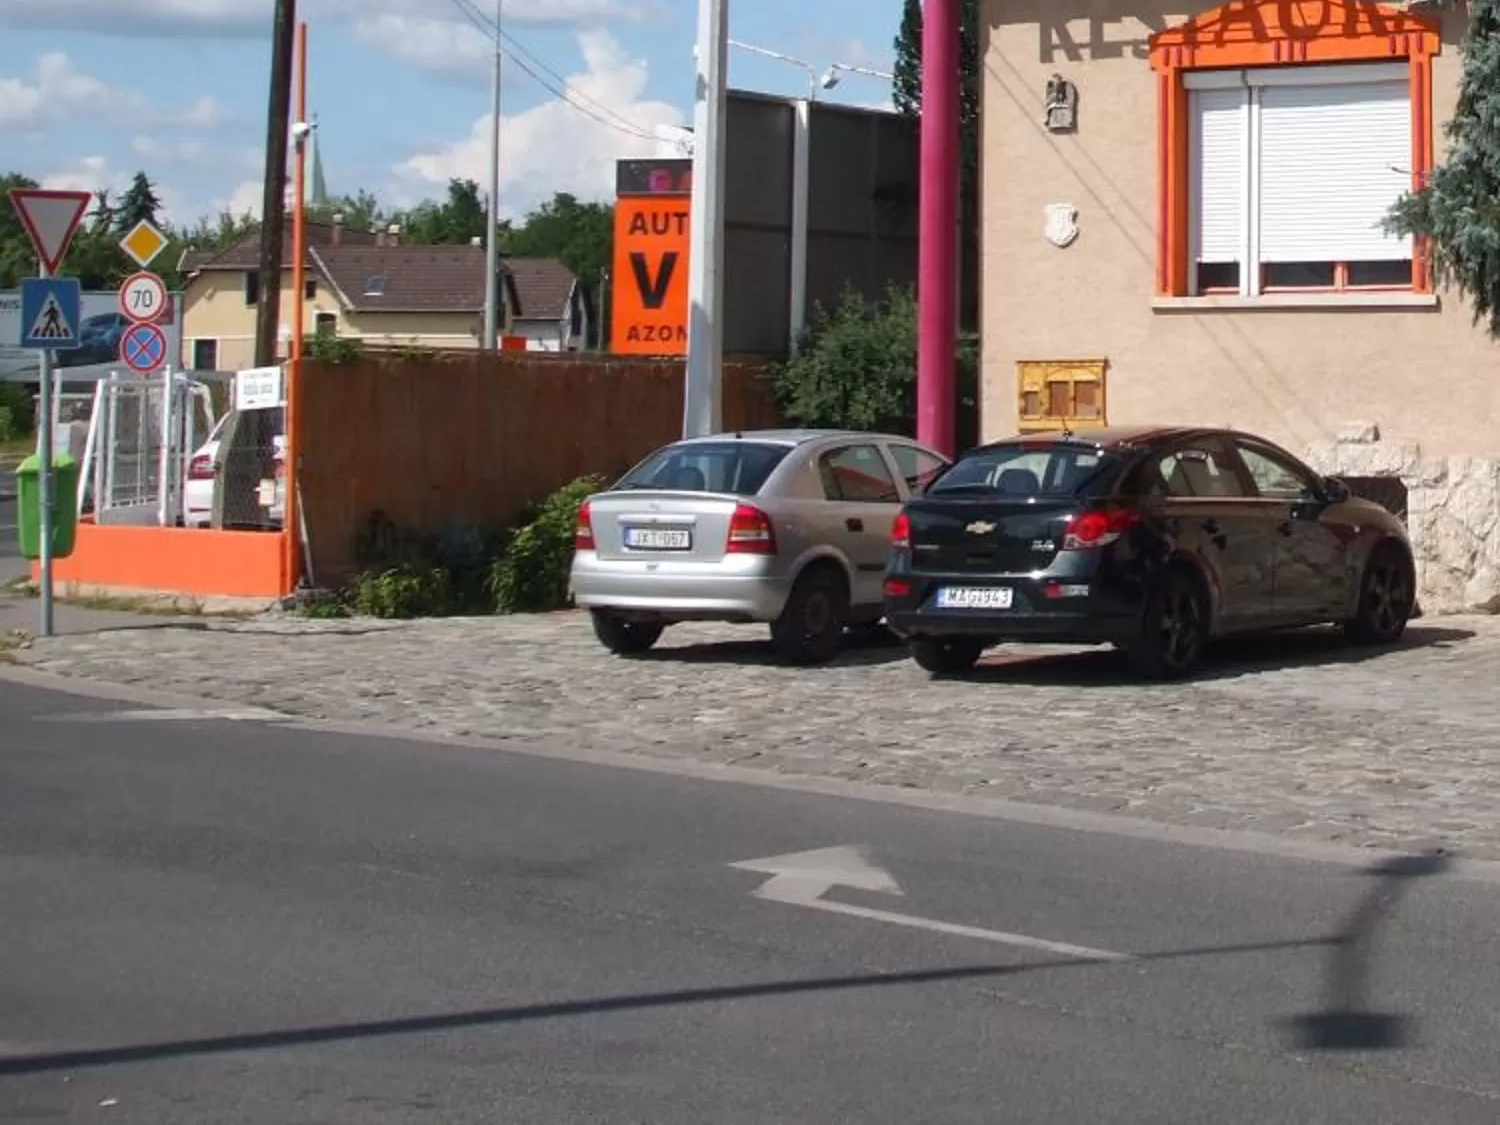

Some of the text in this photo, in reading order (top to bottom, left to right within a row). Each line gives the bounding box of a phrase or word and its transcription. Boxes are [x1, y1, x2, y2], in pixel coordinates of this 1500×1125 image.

[629, 211, 688, 236] AUT
[629, 251, 679, 309] V
[132, 290, 153, 309] 70
[626, 325, 688, 342] AZON
